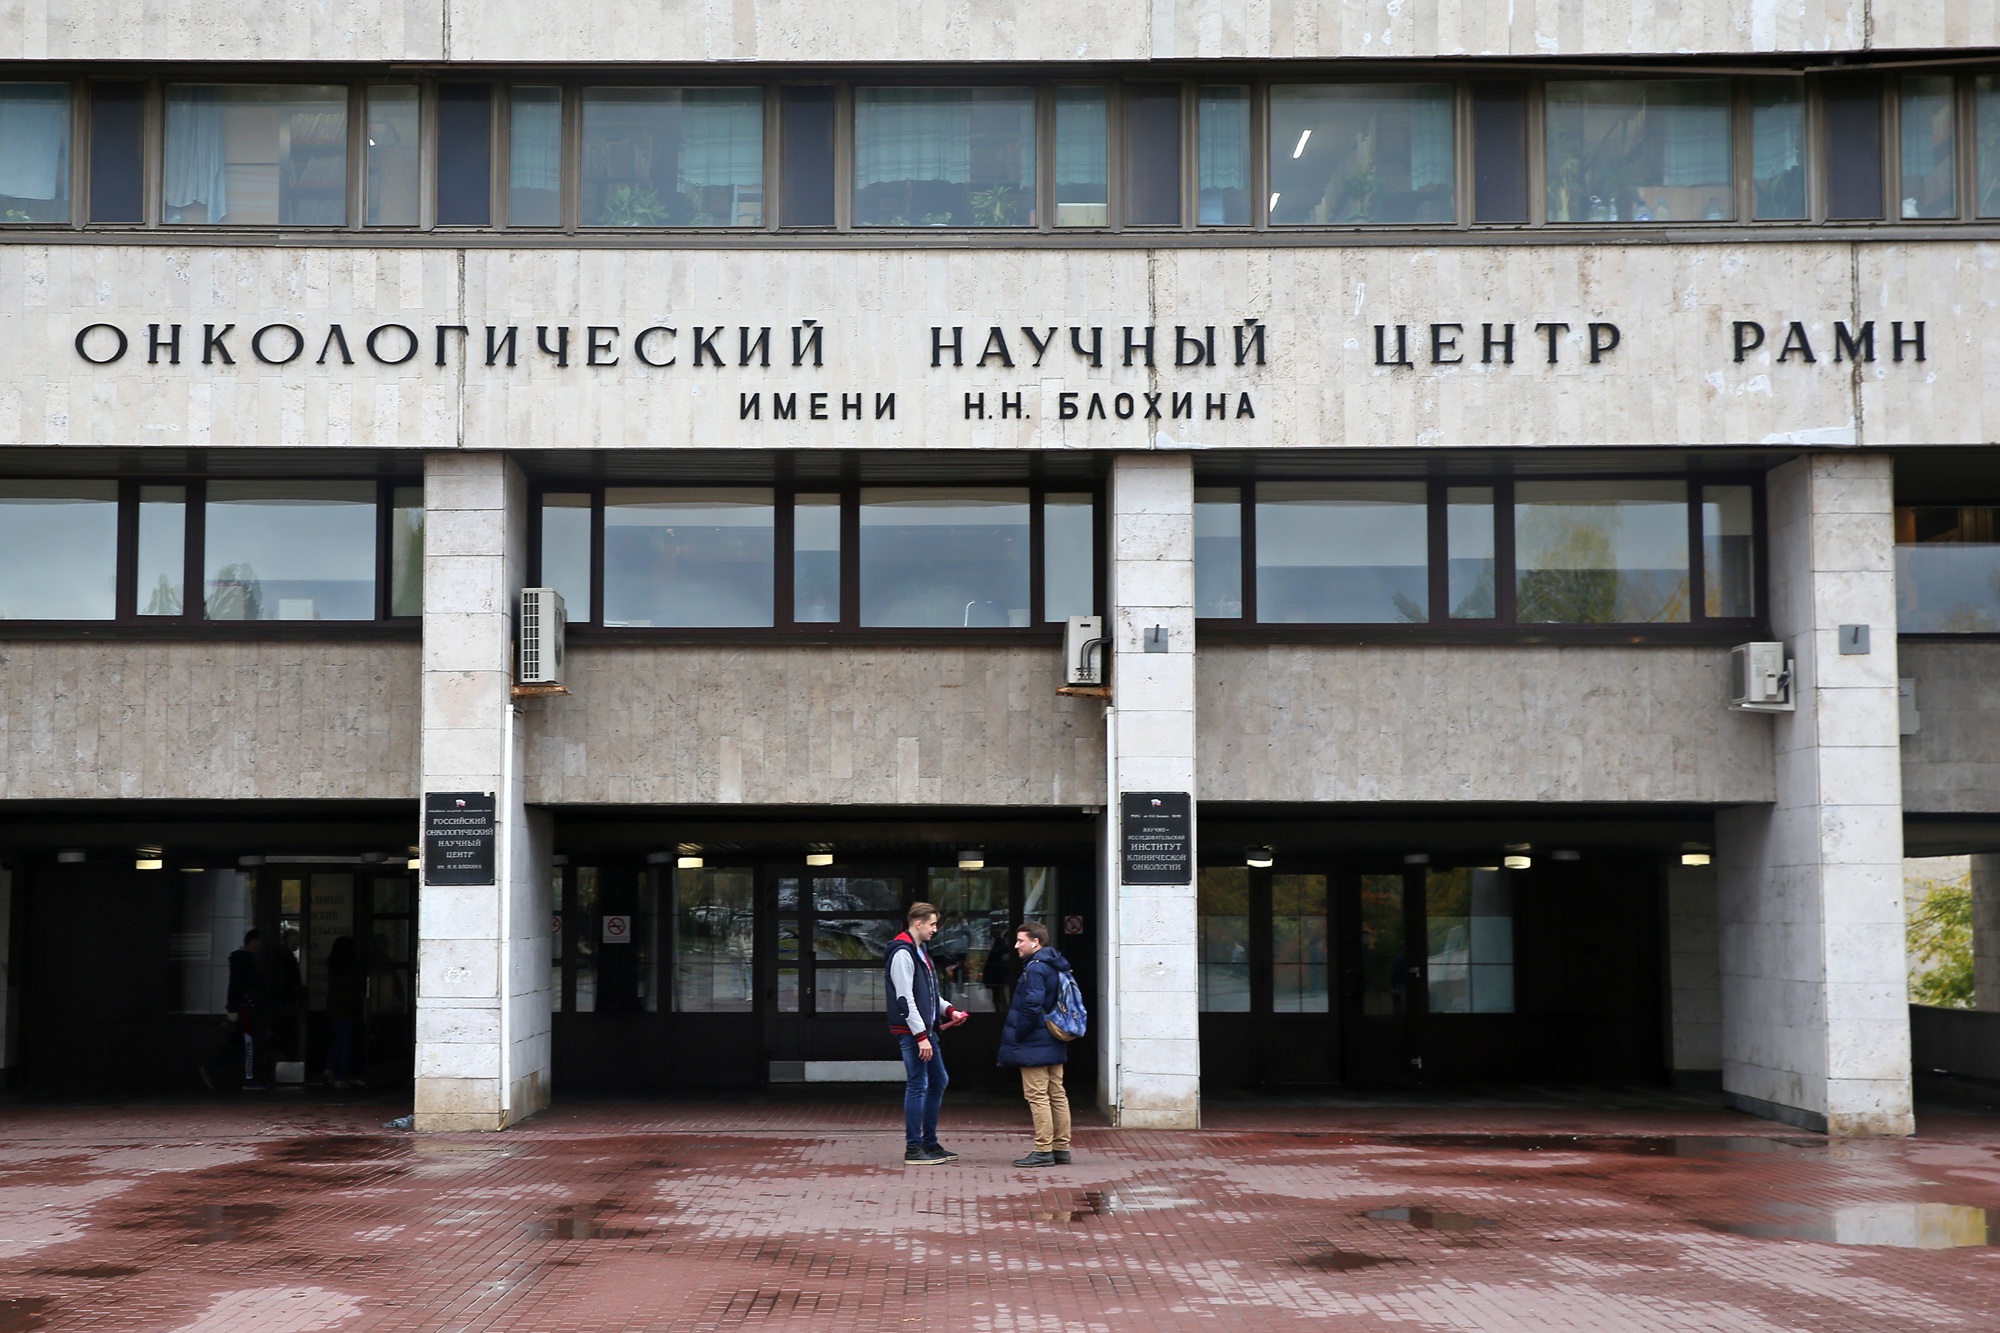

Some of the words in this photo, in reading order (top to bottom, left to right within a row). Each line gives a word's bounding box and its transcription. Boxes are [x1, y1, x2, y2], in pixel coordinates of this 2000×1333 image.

[74, 319, 824, 369] ОНКОЛОГИЧЕСКИЙ
[930, 318, 1267, 372] НАУЧНЫЙ
[1373, 322, 1621, 371] ЦЕНТР
[1732, 320, 1926, 365] РАМН
[740, 392, 895, 421] ИМЕНИ
[1058, 391, 1255, 422] БЛОХИНА
[433, 817, 486, 825] РОССИЙСКИЙ
[426, 828, 493, 836] ОНКОЛОГИЧЕСКИЙ
[438, 839, 481, 847] НАУЧНЫЙ
